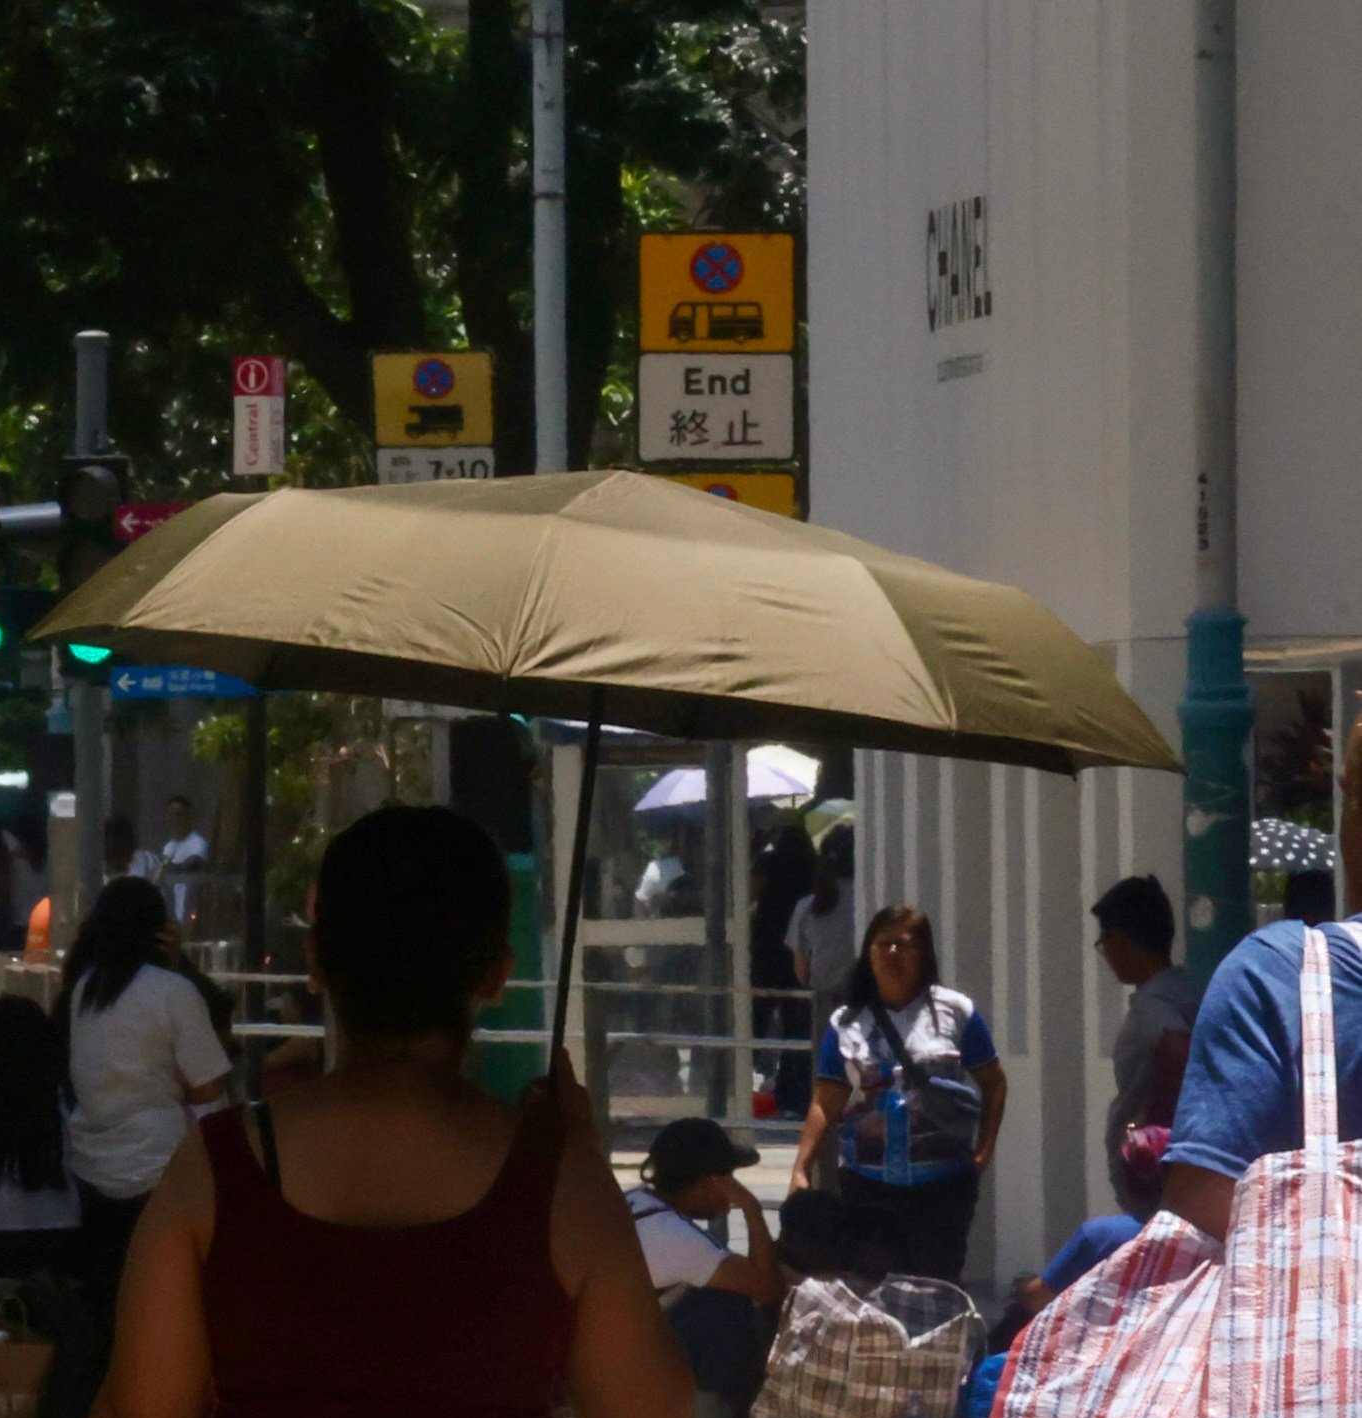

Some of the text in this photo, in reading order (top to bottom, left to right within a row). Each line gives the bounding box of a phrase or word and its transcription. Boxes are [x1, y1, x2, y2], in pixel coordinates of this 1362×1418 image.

[927, 196, 993, 333] CHANEL
[684, 367, 751, 396] End
[244, 403, 259, 466] Central
[669, 409, 763, 447] 終止
